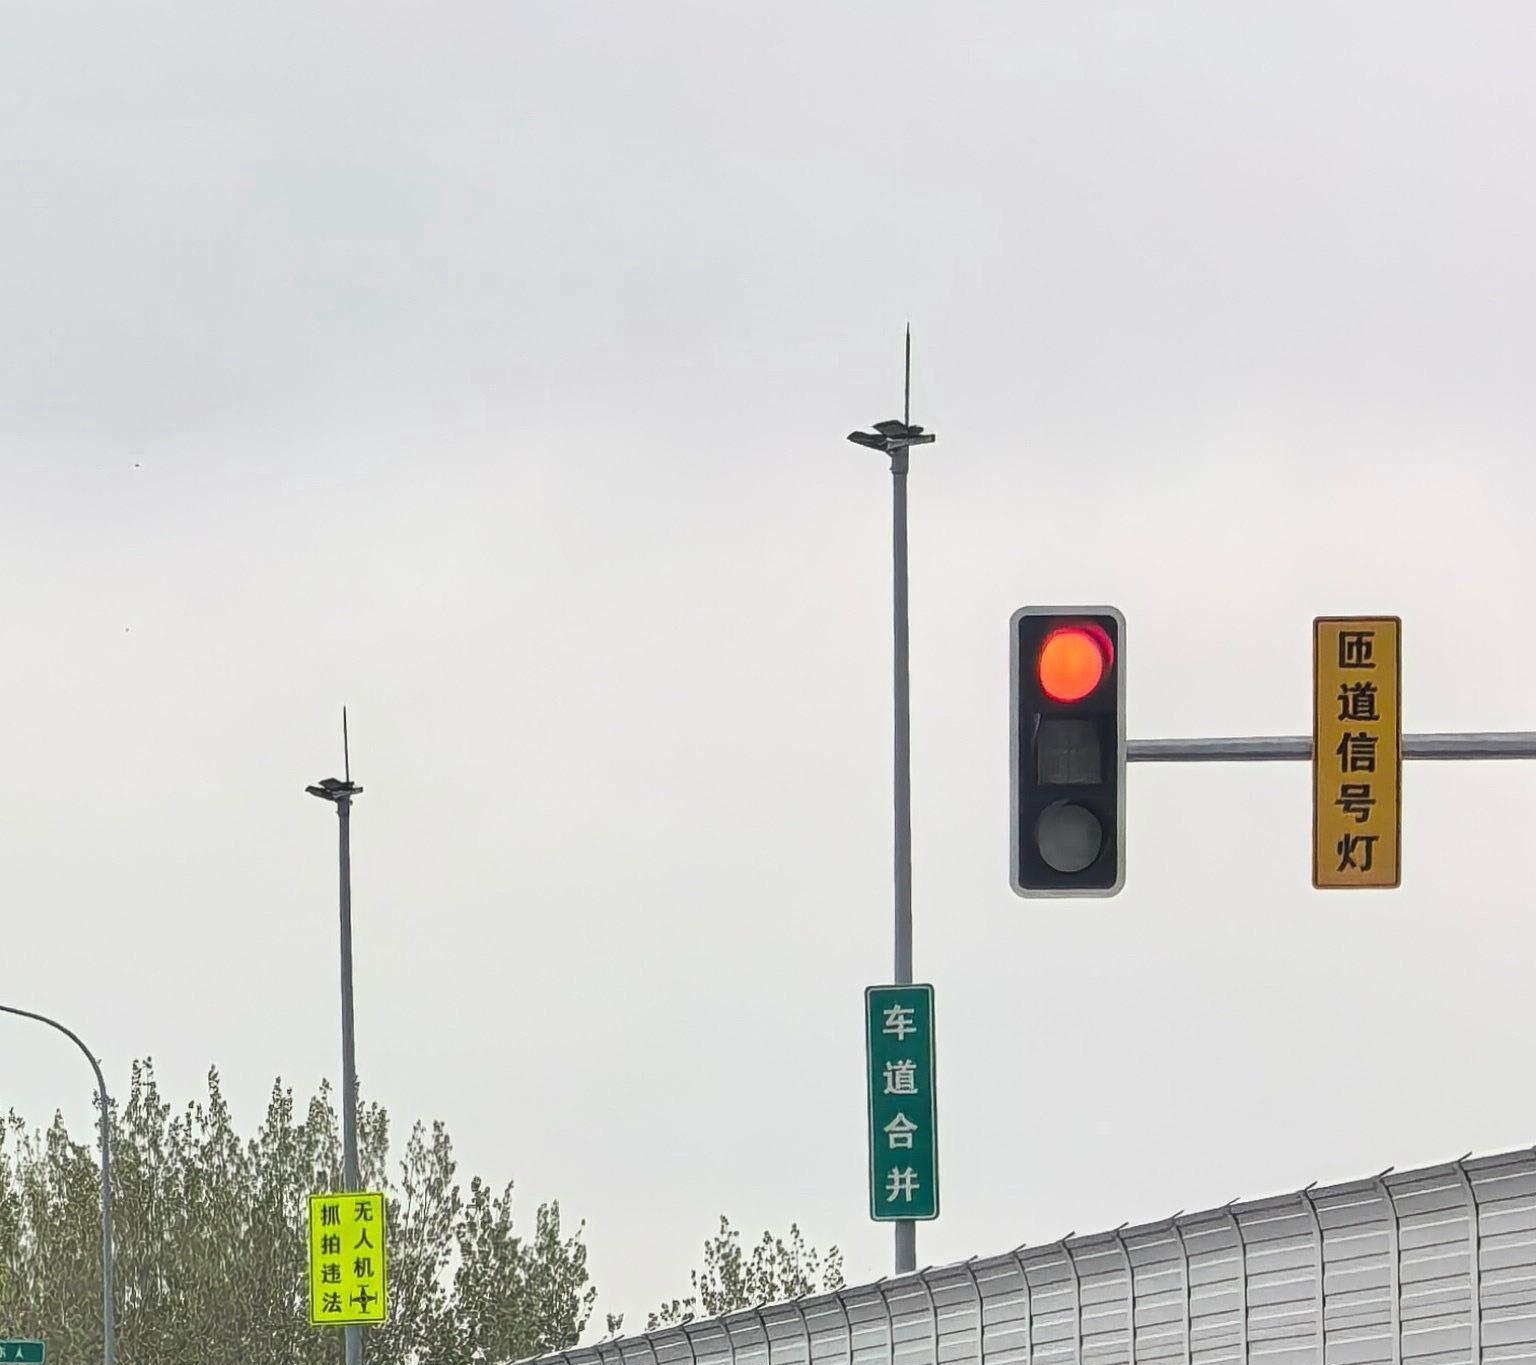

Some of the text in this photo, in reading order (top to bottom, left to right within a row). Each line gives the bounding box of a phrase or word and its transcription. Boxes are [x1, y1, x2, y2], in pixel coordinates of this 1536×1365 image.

[1335, 630, 1380, 873] 匝道信号灯
[882, 1004, 920, 1203] 车道合并
[321, 1204, 342, 1313] 抓拍违法
[353, 1201, 374, 1278] 无人机
